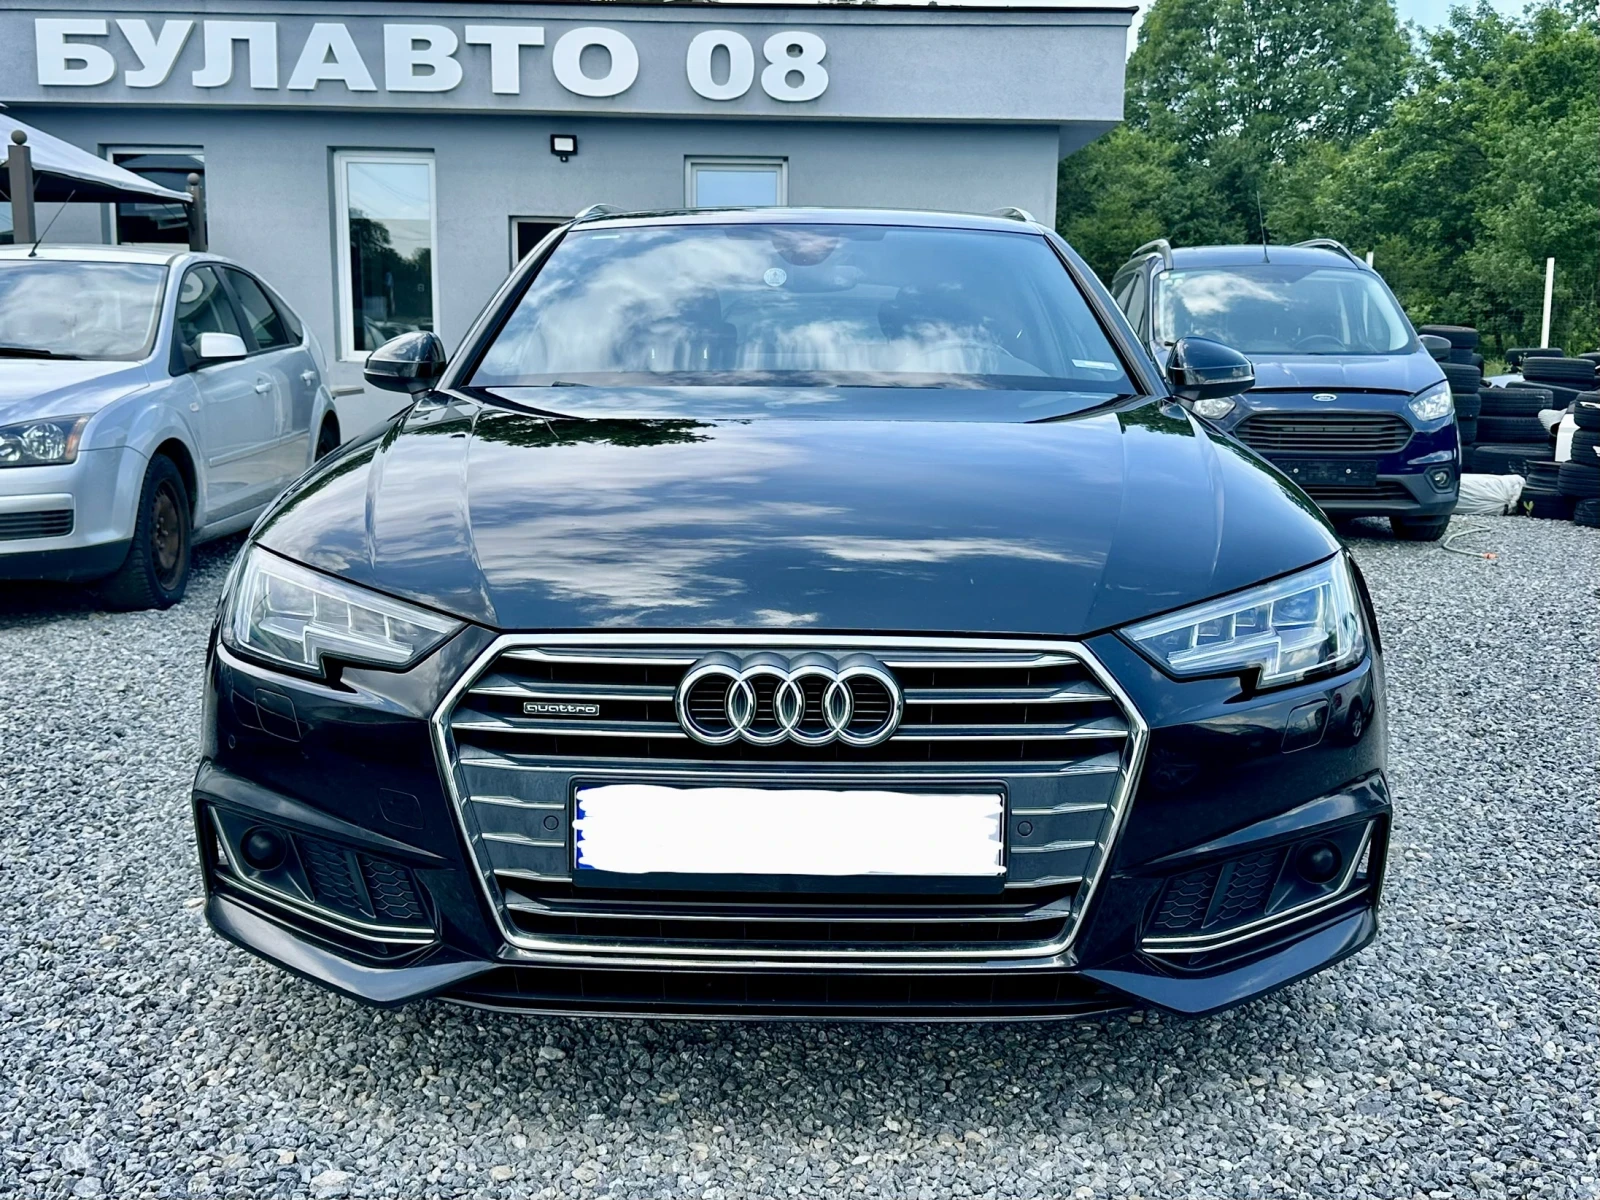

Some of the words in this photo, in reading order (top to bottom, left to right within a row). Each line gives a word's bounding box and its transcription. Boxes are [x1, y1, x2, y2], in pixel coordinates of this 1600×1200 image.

[34, 18, 640, 98] БУЛАВТО
[686, 29, 829, 102] 08
[526, 704, 597, 714] quattro
